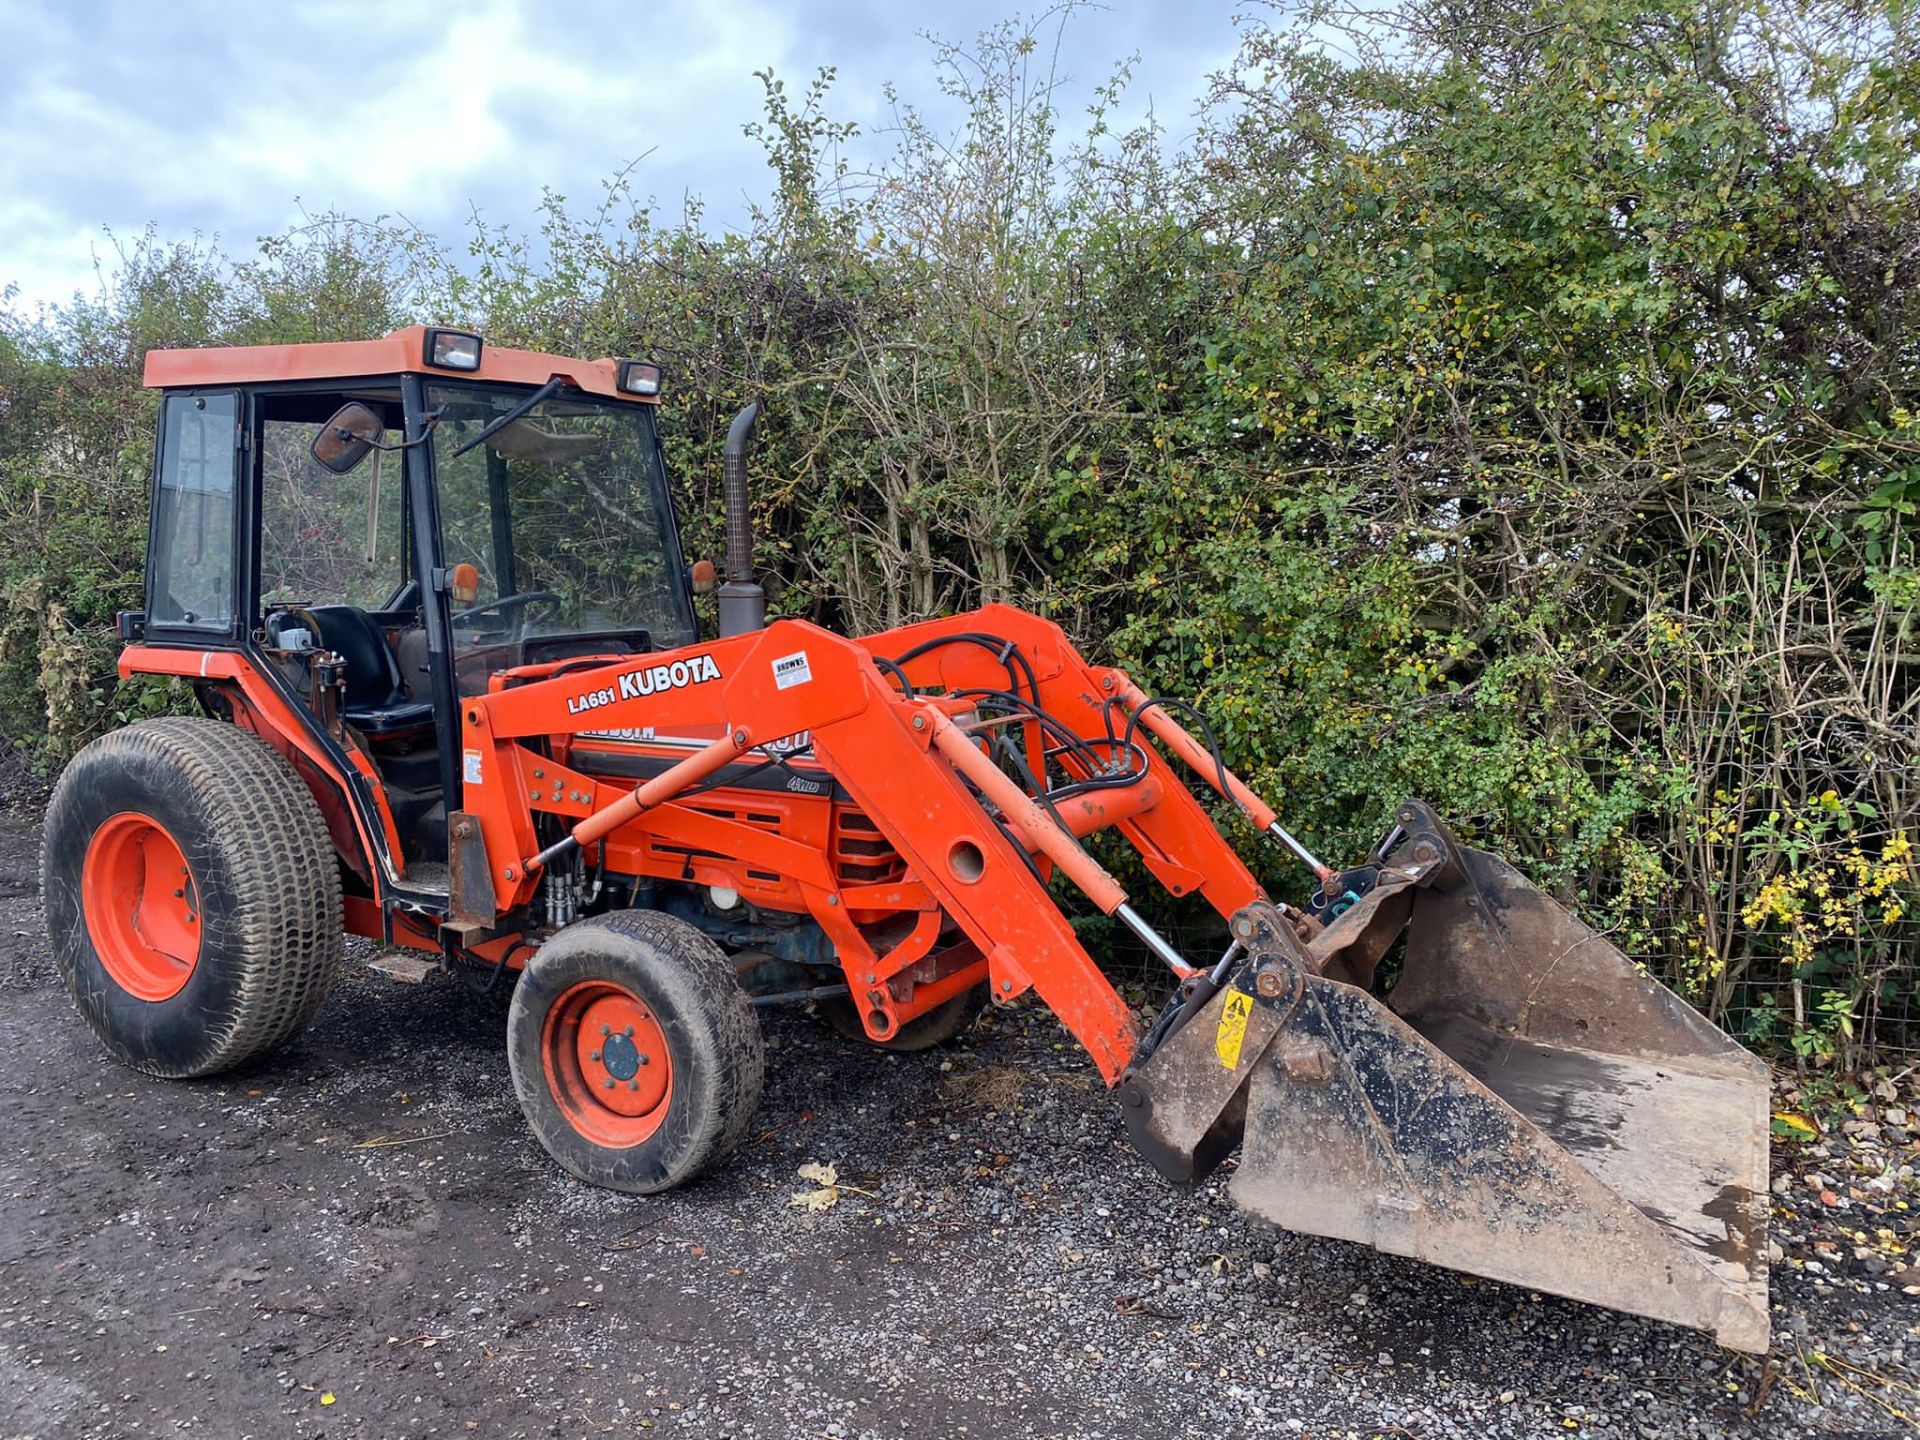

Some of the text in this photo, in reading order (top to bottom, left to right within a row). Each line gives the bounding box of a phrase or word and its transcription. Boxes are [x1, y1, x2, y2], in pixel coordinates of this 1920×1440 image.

[567, 653, 722, 714] LA681 KUBOTA
[787, 776, 820, 793] 4WD
